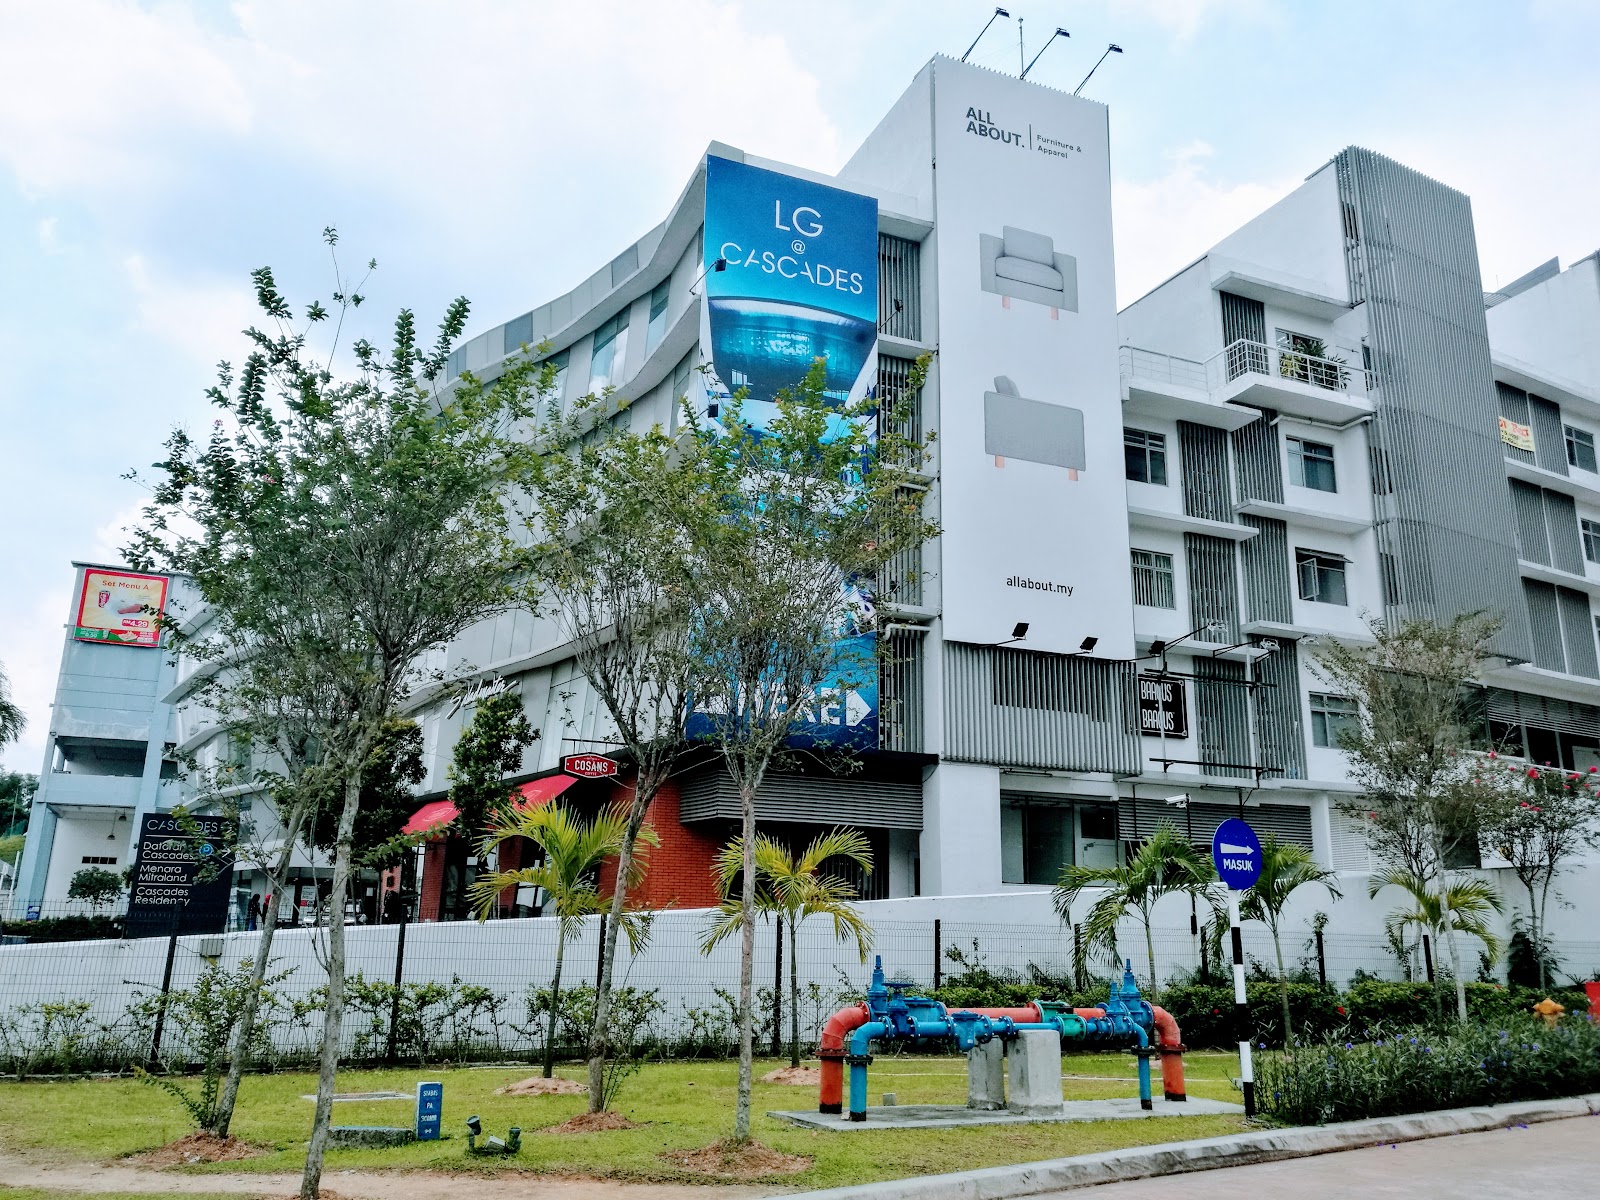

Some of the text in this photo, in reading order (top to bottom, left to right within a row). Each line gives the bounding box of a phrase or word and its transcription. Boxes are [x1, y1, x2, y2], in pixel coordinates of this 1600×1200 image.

[966, 107, 994, 125] ALL
[966, 121, 1025, 148] ABOUT.
[1037, 134, 1074, 151] Furniture
[1038, 145, 1068, 159] Apparel
[775, 200, 823, 237] LG
[791, 239, 806, 254] @
[720, 242, 863, 294] CASCADES
[118, 582, 141, 590] Menu
[1006, 575, 1074, 597] allabout.my
[574, 760, 608, 772] COSANS
[147, 819, 218, 833] CASCDES
[142, 850, 194, 860] Cascades
[140, 864, 182, 873] Menara
[1223, 858, 1253, 872] MASUK
[138, 873, 187, 883] Mitraland
[137, 886, 189, 896] Cascades
